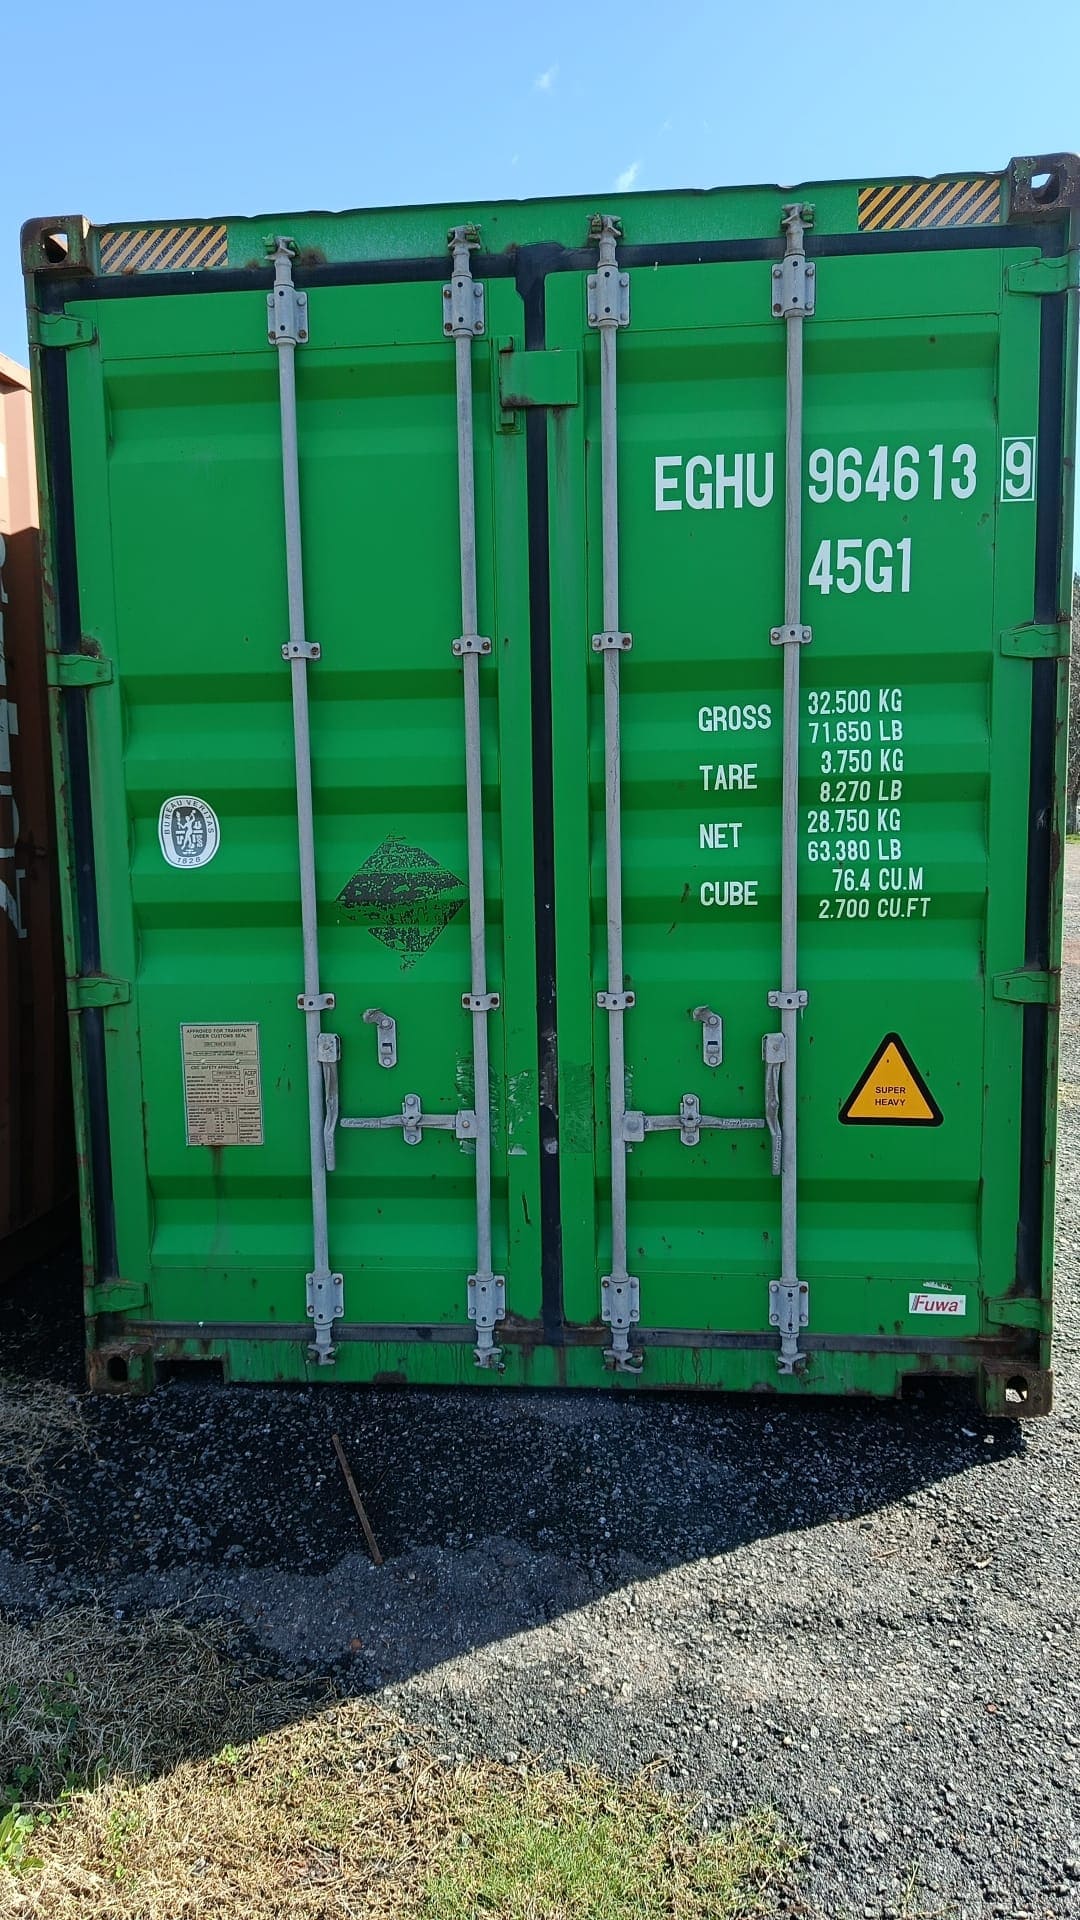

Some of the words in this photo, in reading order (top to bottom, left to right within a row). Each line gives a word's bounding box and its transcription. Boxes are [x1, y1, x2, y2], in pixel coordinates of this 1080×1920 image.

[656, 452, 774, 511] EGHU
[808, 443, 977, 504] 964613
[1005, 441, 1032, 498] 9
[808, 537, 912, 595] 45G1
[879, 688, 902, 713] KG
[698, 704, 772, 732] GROSS
[879, 719, 903, 741] LB
[880, 749, 904, 772] KG
[699, 763, 758, 791] TARE
[878, 779, 903, 801] LB
[877, 808, 901, 832] KG
[699, 822, 743, 849] NET
[878, 838, 902, 860] LB
[832, 868, 871, 892] 76.4
[879, 867, 923, 891] CU.M
[700, 880, 758, 906] CUBE
[877, 897, 931, 918] CU.FT
[875, 1086, 906, 1094] SUPER
[874, 1098, 906, 1107] HEAVY
[911, 1294, 959, 1312] Fuwa
